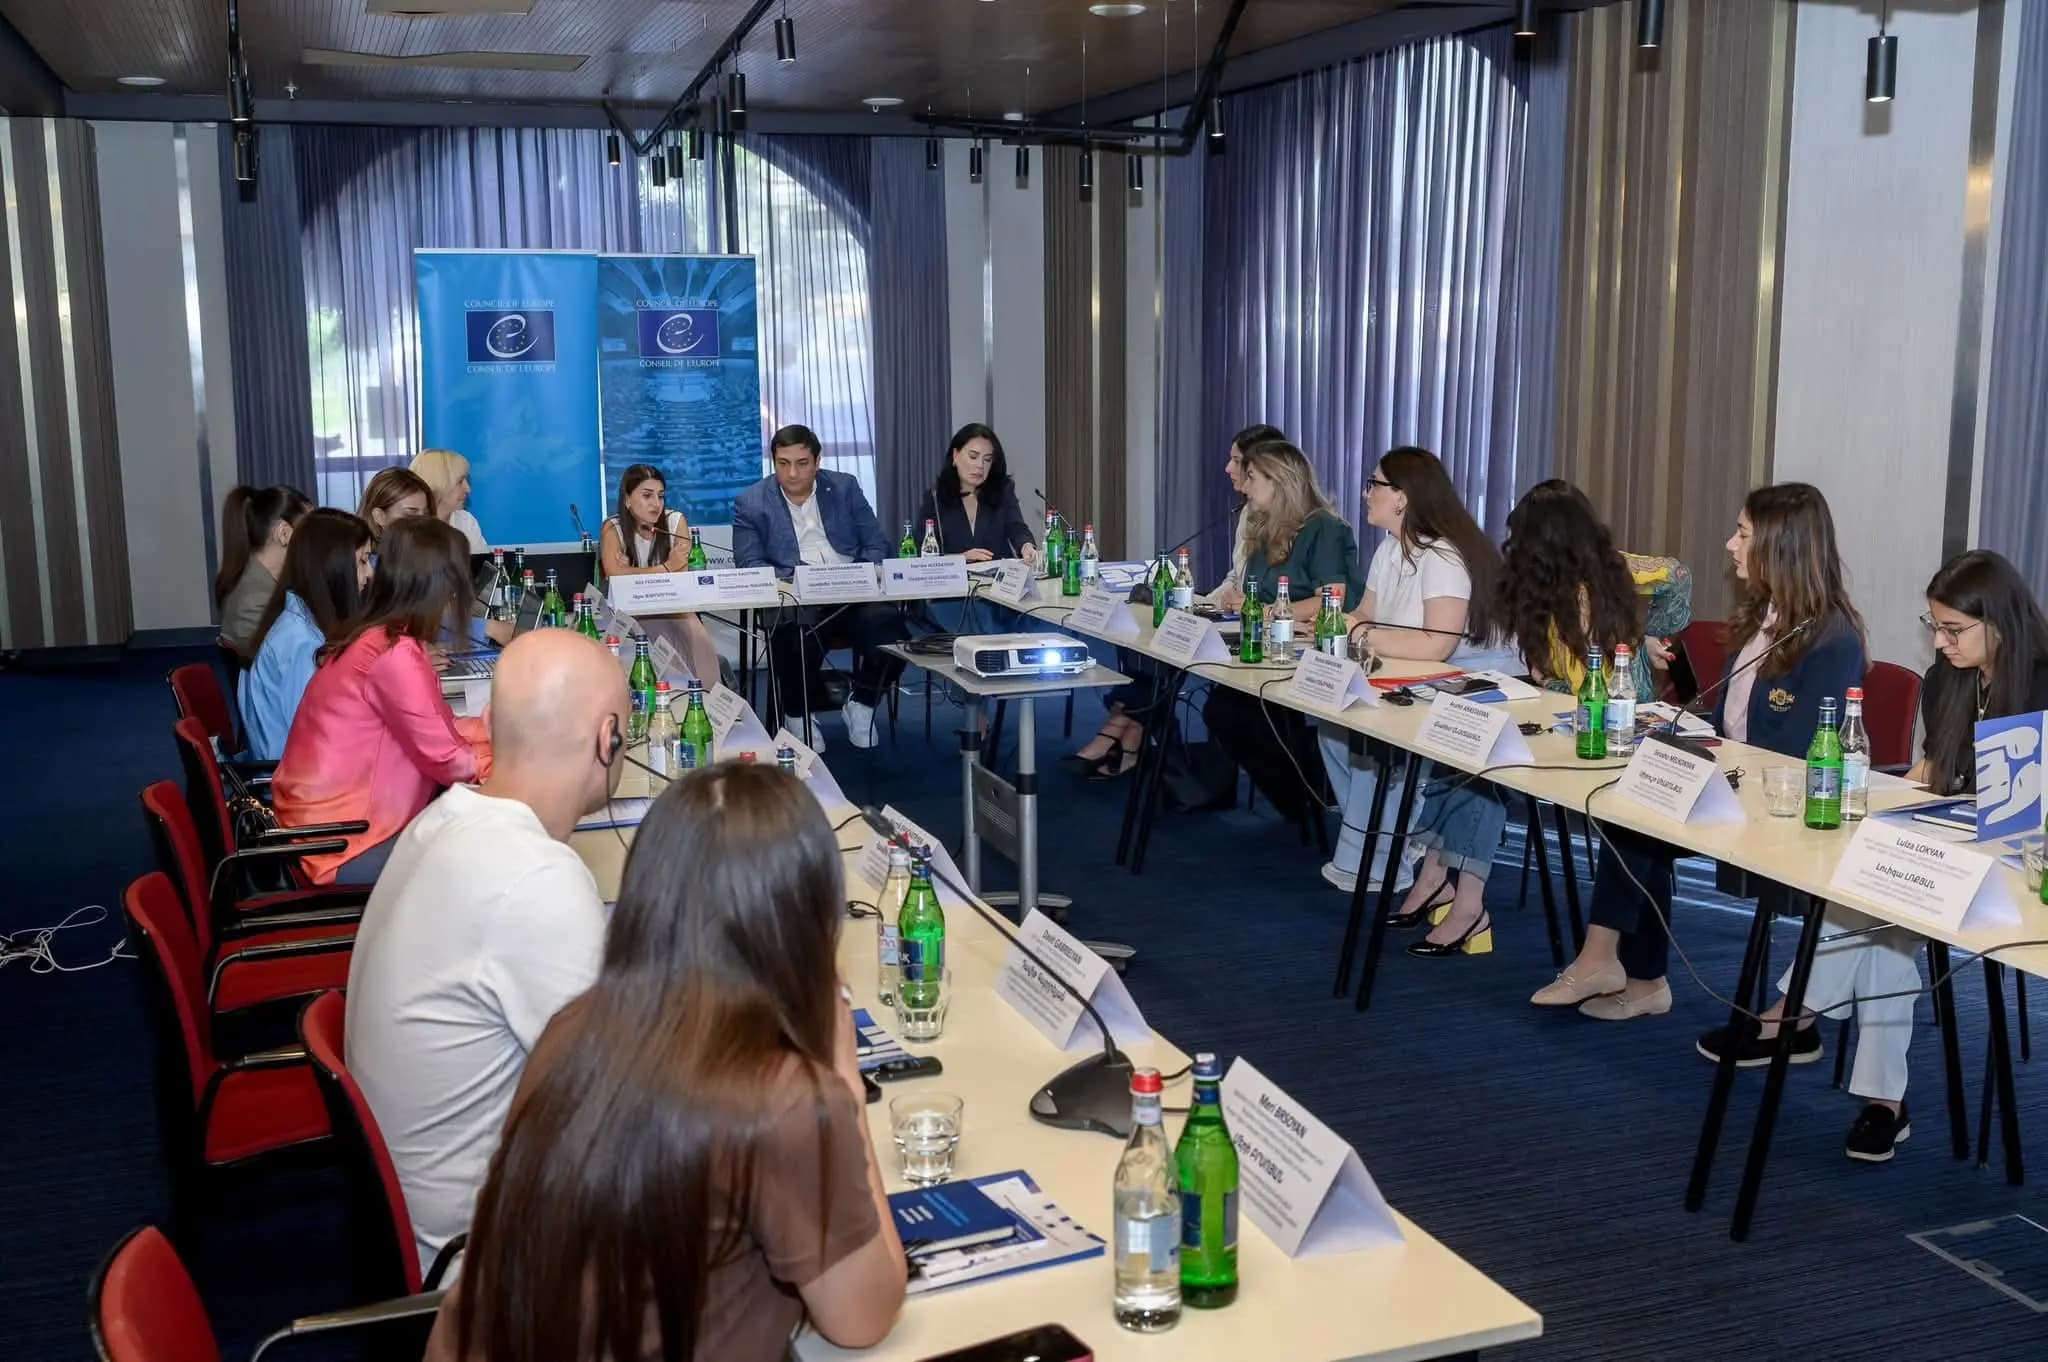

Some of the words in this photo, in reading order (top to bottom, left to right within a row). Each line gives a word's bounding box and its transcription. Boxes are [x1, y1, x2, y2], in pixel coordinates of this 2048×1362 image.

[464, 299, 503, 308] COUNCIL
[522, 299, 555, 308] EUROPE
[639, 359, 672, 369] CONSEIL
[674, 359, 684, 368] DE
[1896, 838, 1915, 850] Luiza
